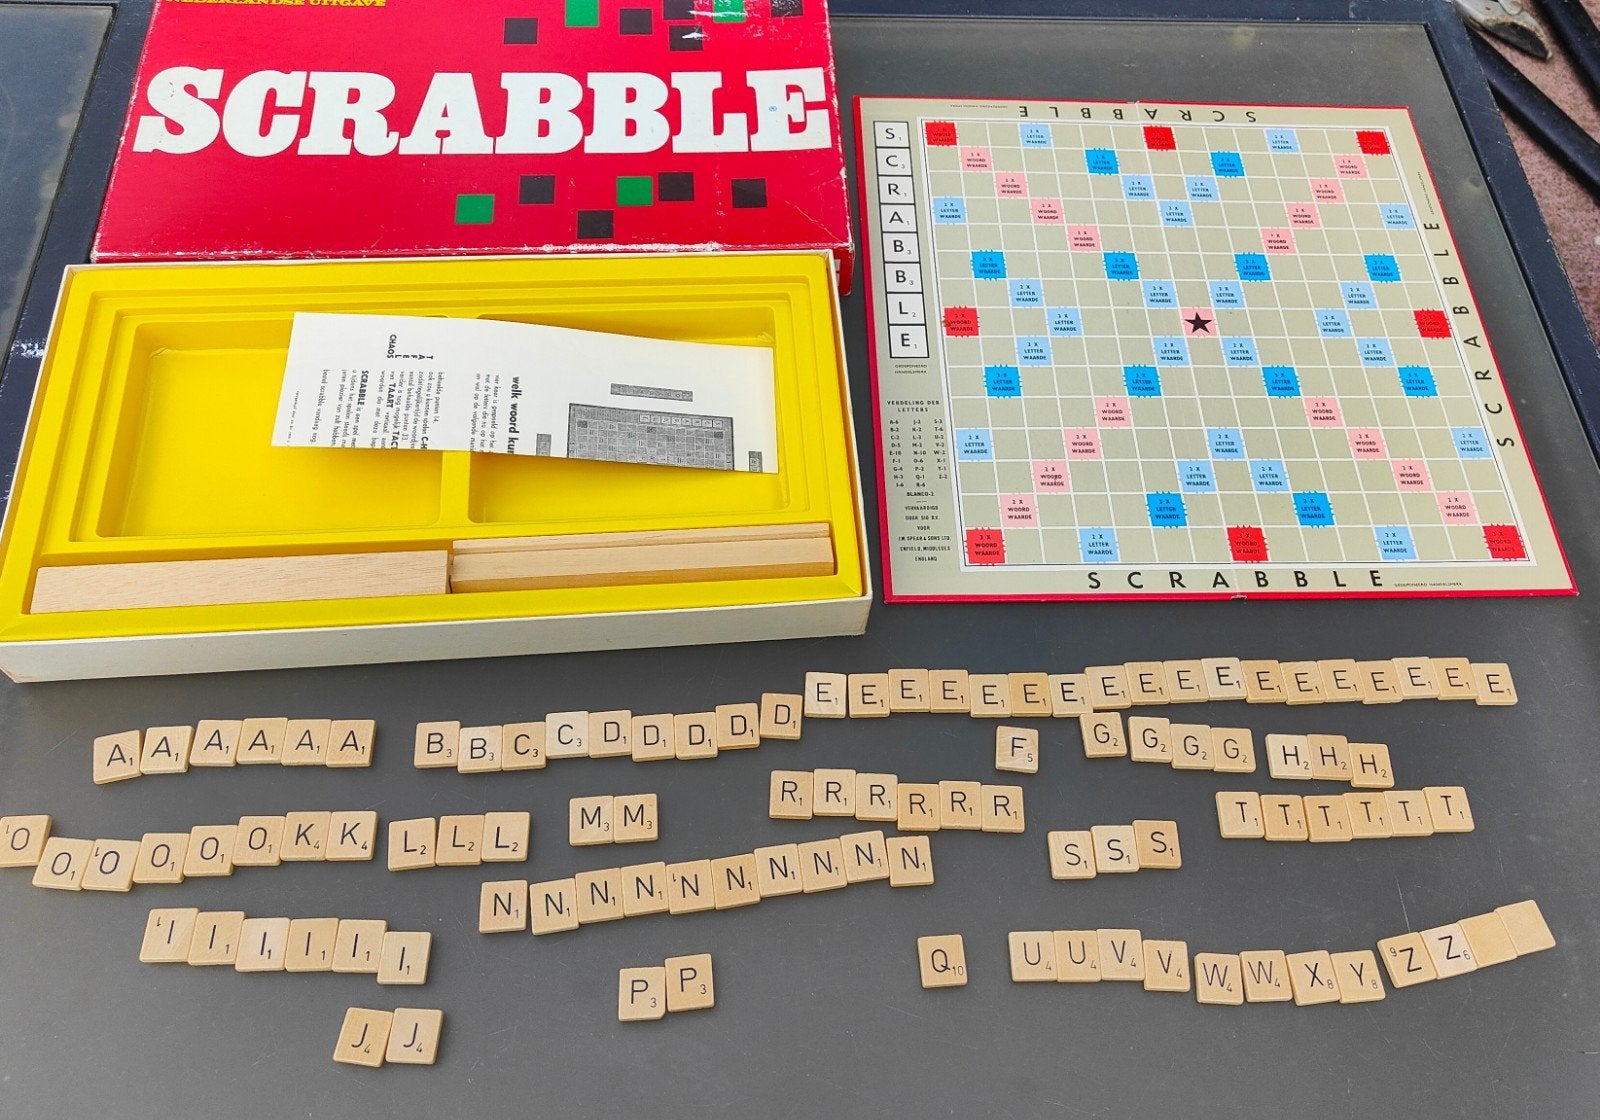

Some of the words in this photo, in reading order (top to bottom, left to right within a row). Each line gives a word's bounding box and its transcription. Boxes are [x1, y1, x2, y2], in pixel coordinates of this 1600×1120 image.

[133, 66, 832, 157] SCRABBLE
[357, 370, 369, 406] SCRABBLE
[386, 382, 396, 408] TAART
[508, 402, 520, 434] woord
